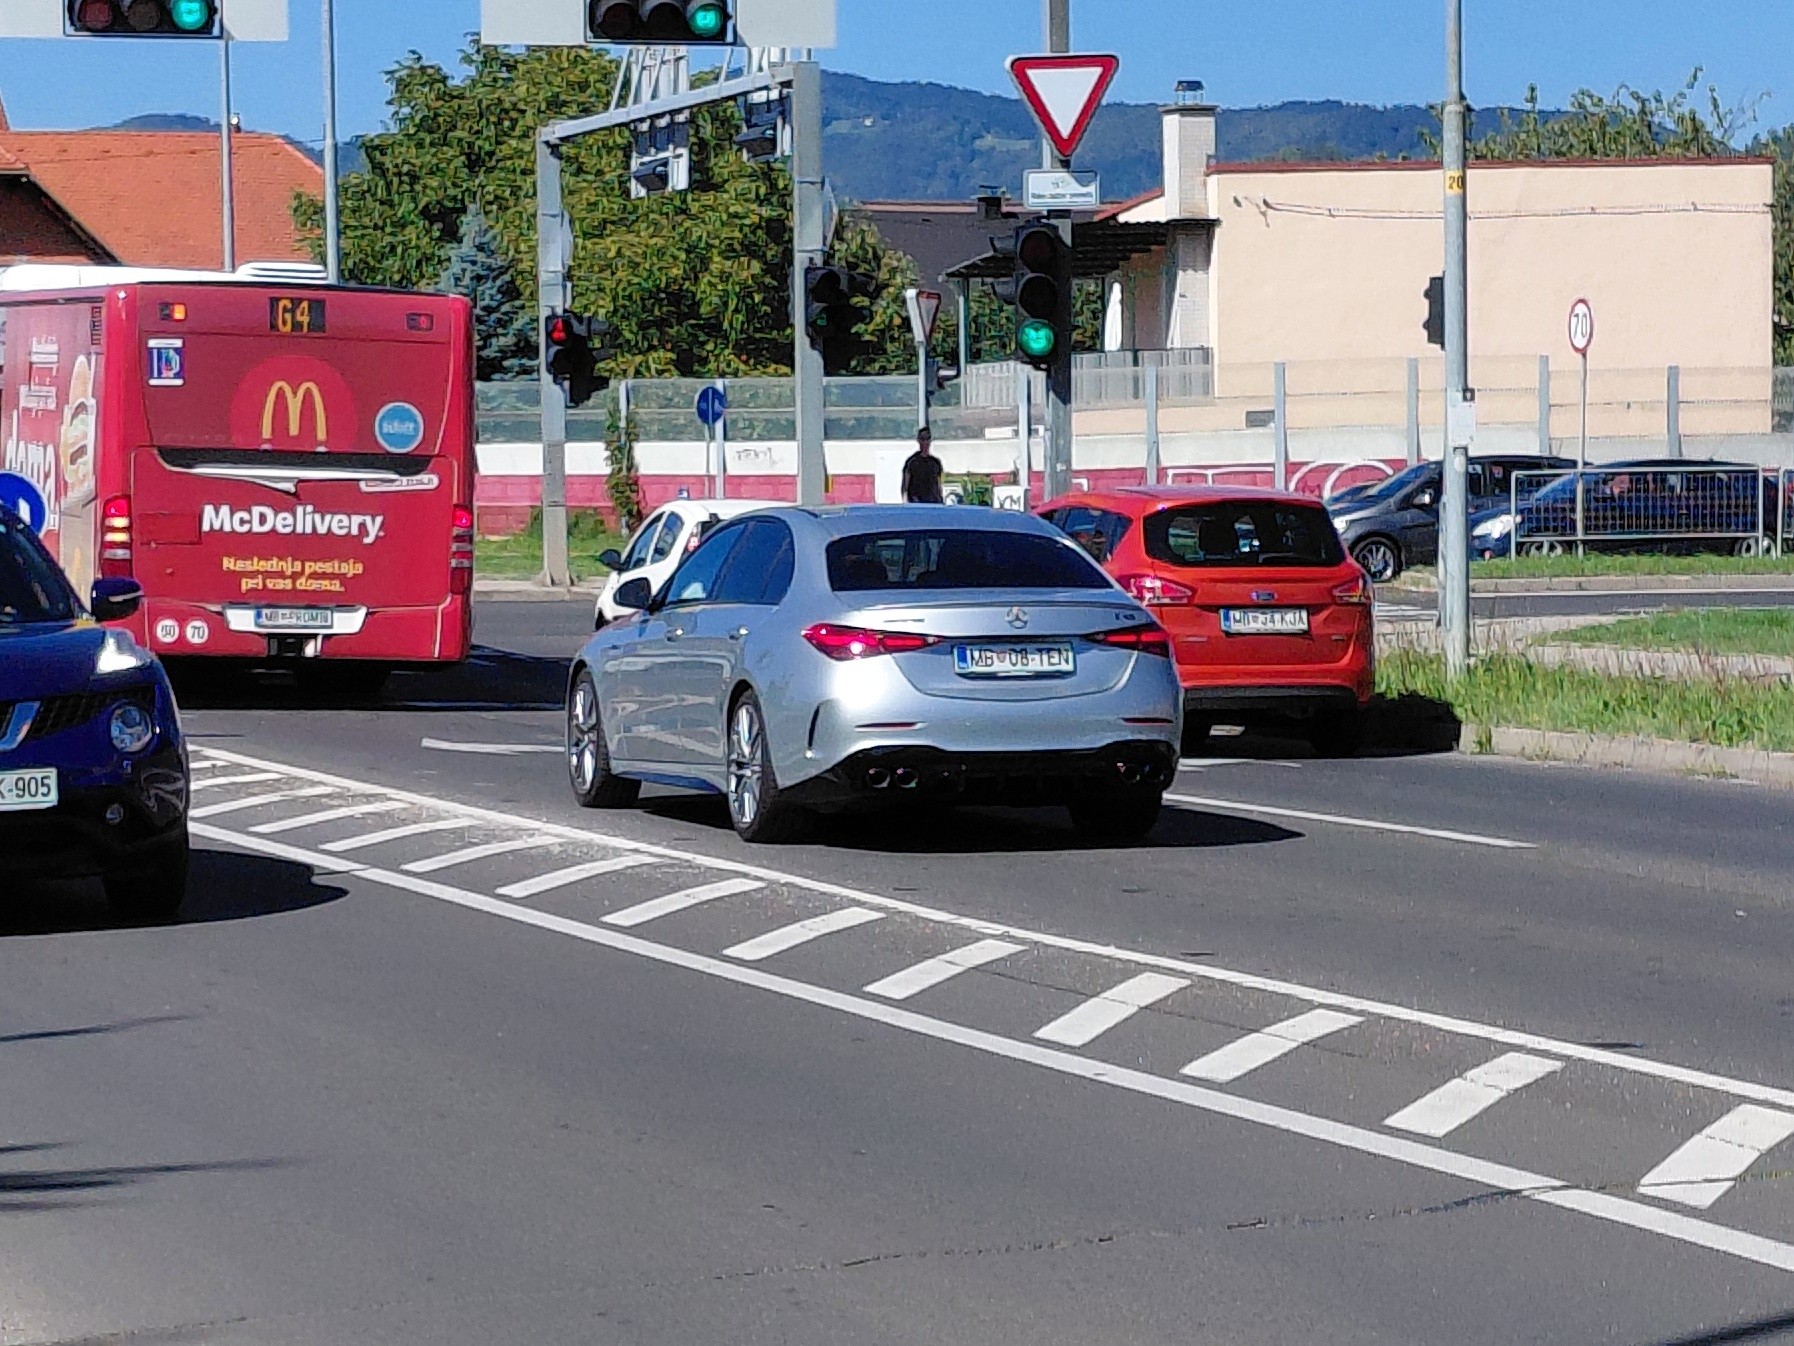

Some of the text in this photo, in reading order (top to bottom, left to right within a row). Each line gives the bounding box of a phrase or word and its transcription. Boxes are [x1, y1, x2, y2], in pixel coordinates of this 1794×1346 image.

[277, 299, 311, 334] G4
[1573, 312, 1588, 340] 70
[202, 504, 384, 544] McDelivery
